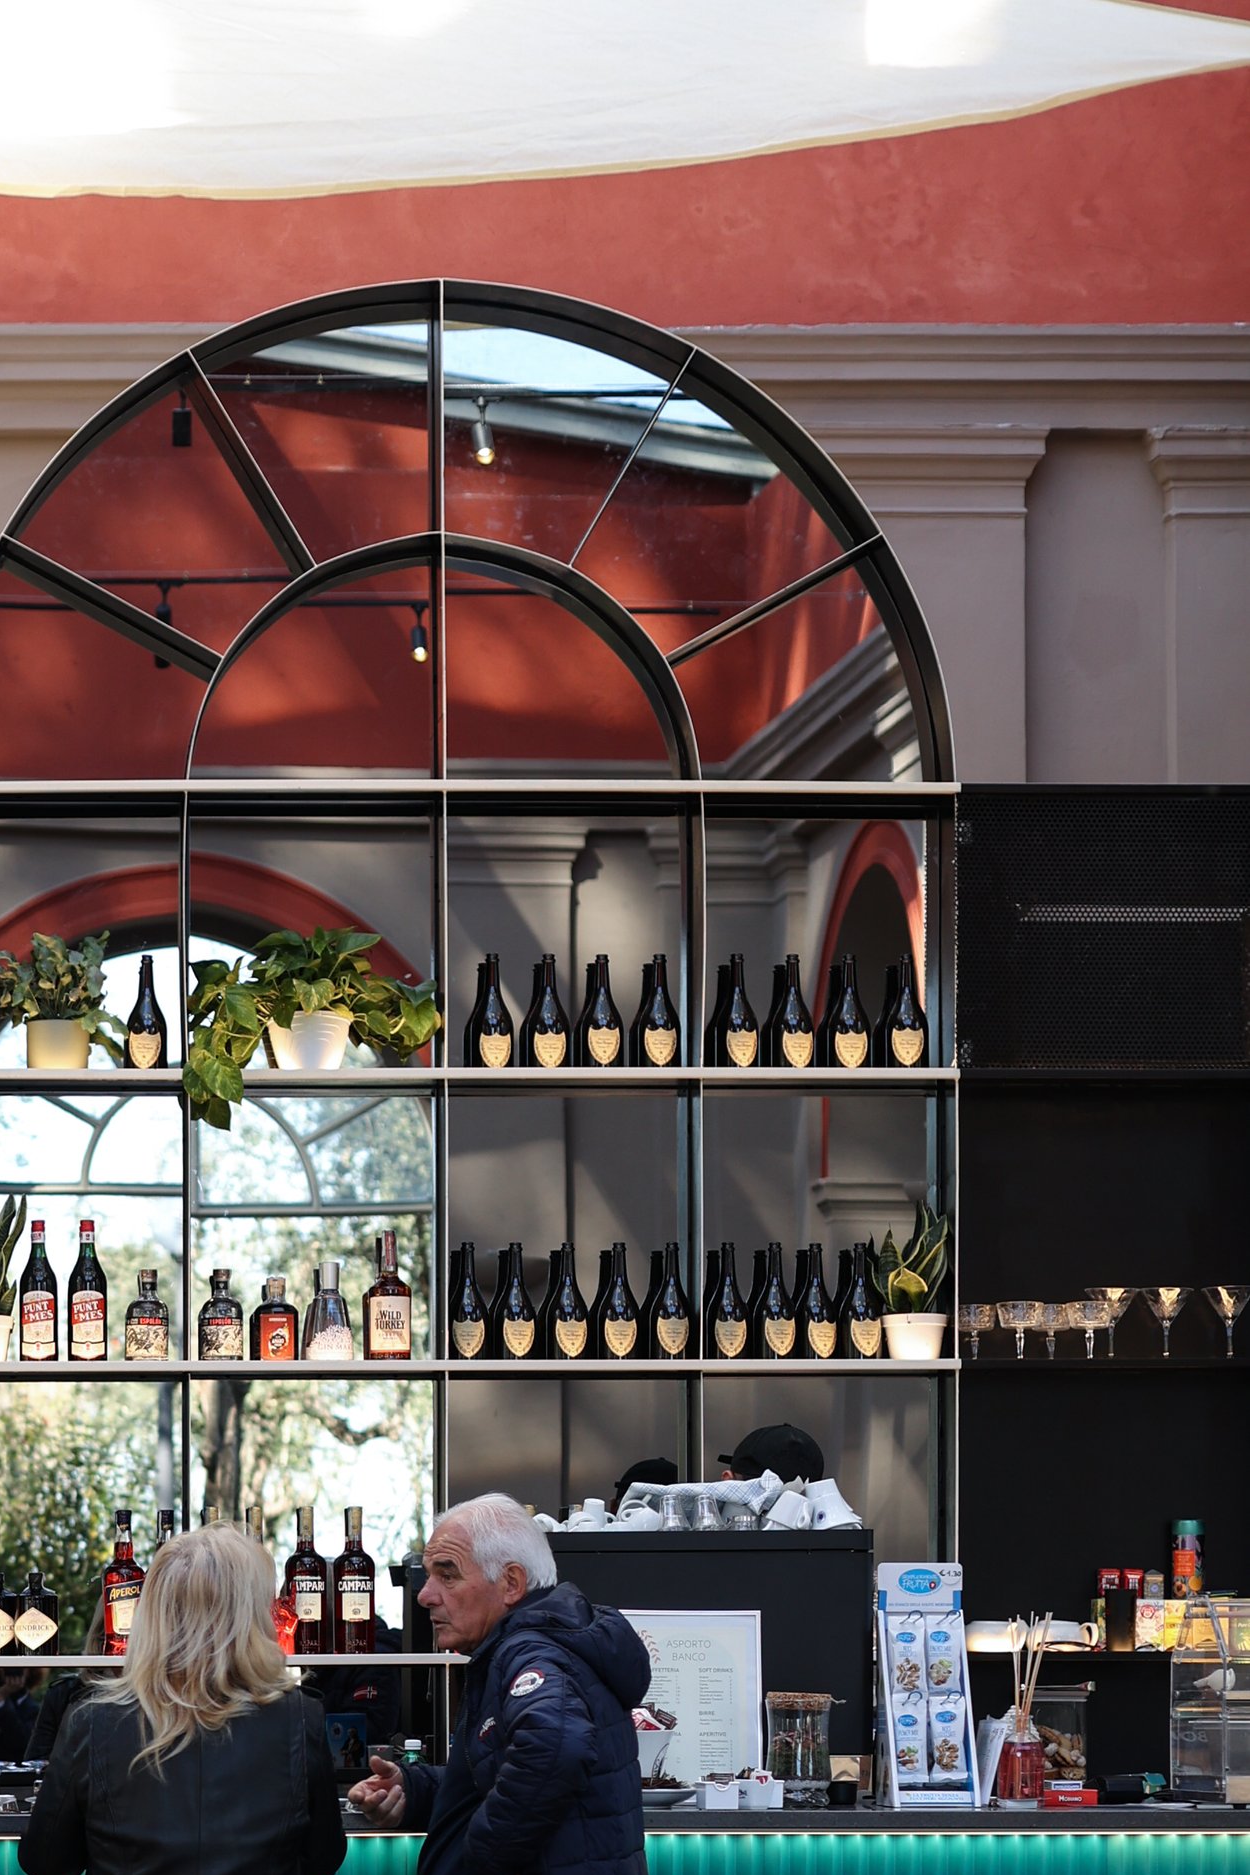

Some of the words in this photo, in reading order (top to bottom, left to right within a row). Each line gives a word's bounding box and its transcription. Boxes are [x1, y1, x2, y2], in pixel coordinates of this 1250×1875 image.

[23, 1301, 49, 1313] PUNT
[73, 1301, 99, 1313] PUNT
[29, 1310, 54, 1322] MES
[79, 1309, 104, 1322] MES
[379, 1310, 402, 1320] WILD
[375, 1318, 406, 1330] TURKEY
[290, 1581, 325, 1591] AMPARI
[338, 1581, 374, 1591] CAMPARI
[109, 1585, 141, 1601] APEROL
[666, 1640, 711, 1649] ASPORTO
[672, 1652, 706, 1661] BANCO
